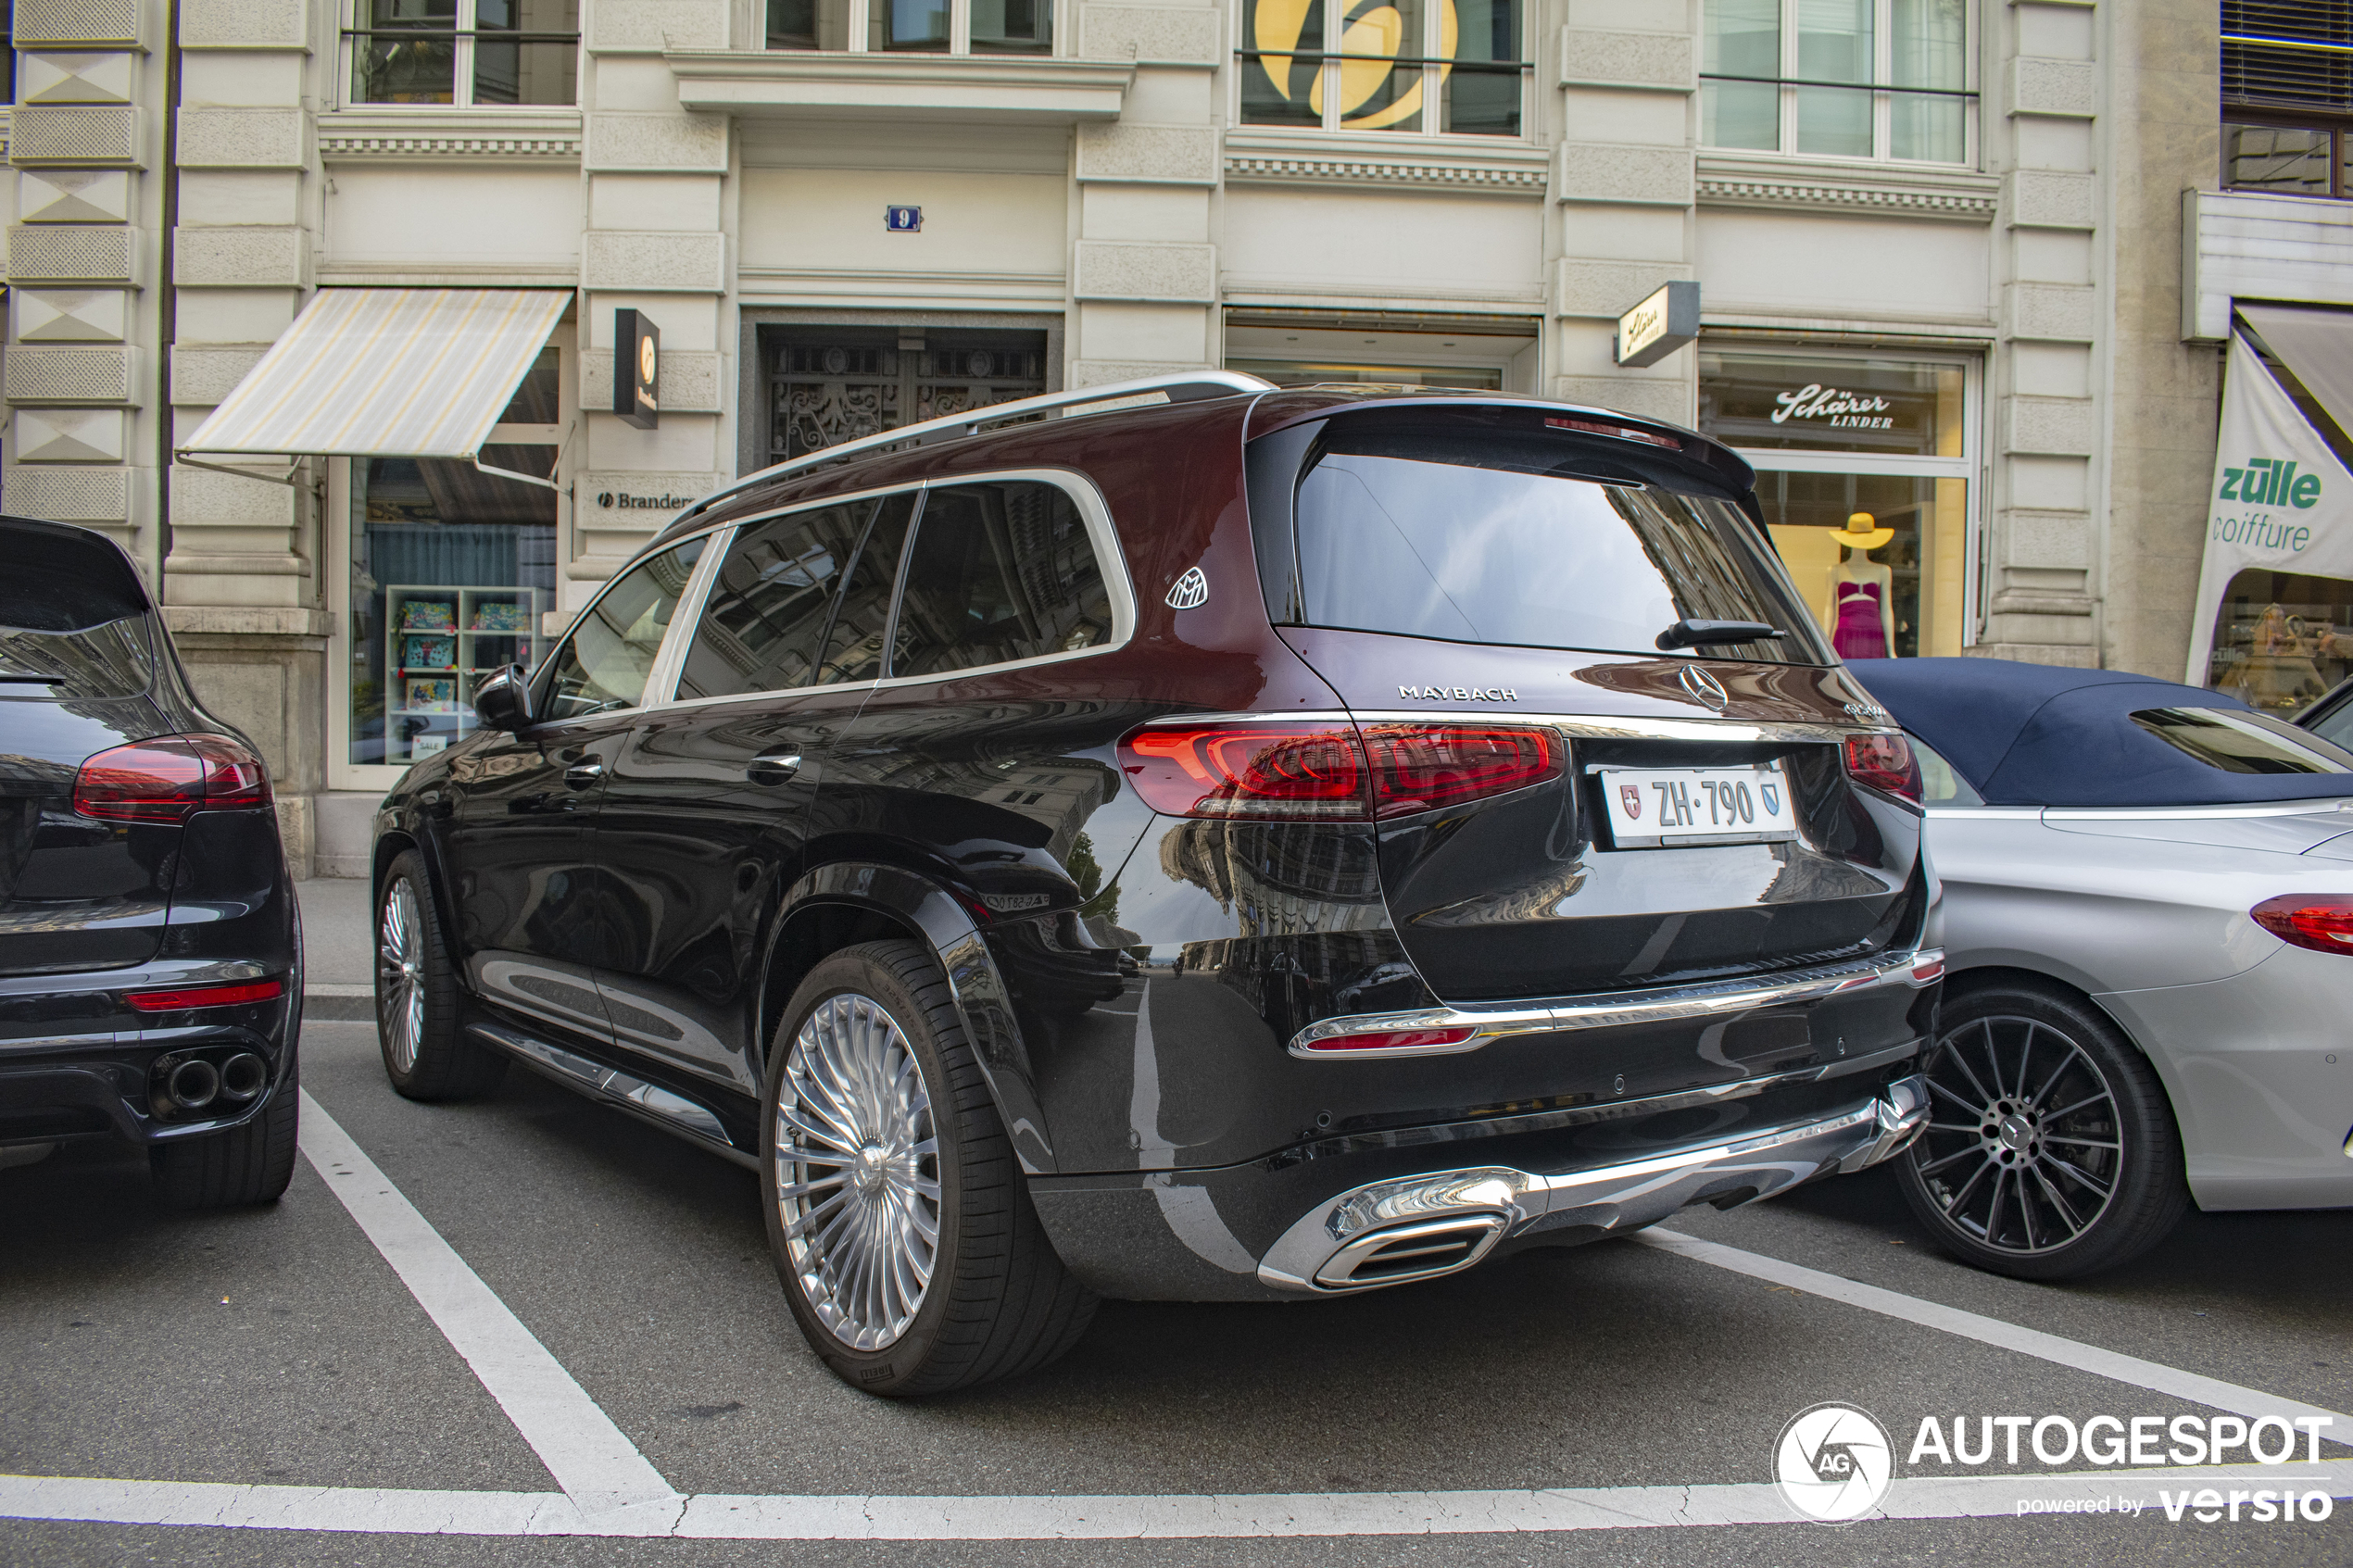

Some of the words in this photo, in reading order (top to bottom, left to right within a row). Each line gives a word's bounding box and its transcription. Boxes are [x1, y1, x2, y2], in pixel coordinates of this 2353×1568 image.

[899, 209, 910, 229] 9
[1770, 383, 1890, 424] Schärer
[1830, 415, 1894, 429] LINDER
[2213, 512, 2309, 552] coiffure
[1398, 685, 1518, 702] MAYBACH
[420, 742, 439, 750] SALE
[860, 1363, 896, 1384] PIRELLI
